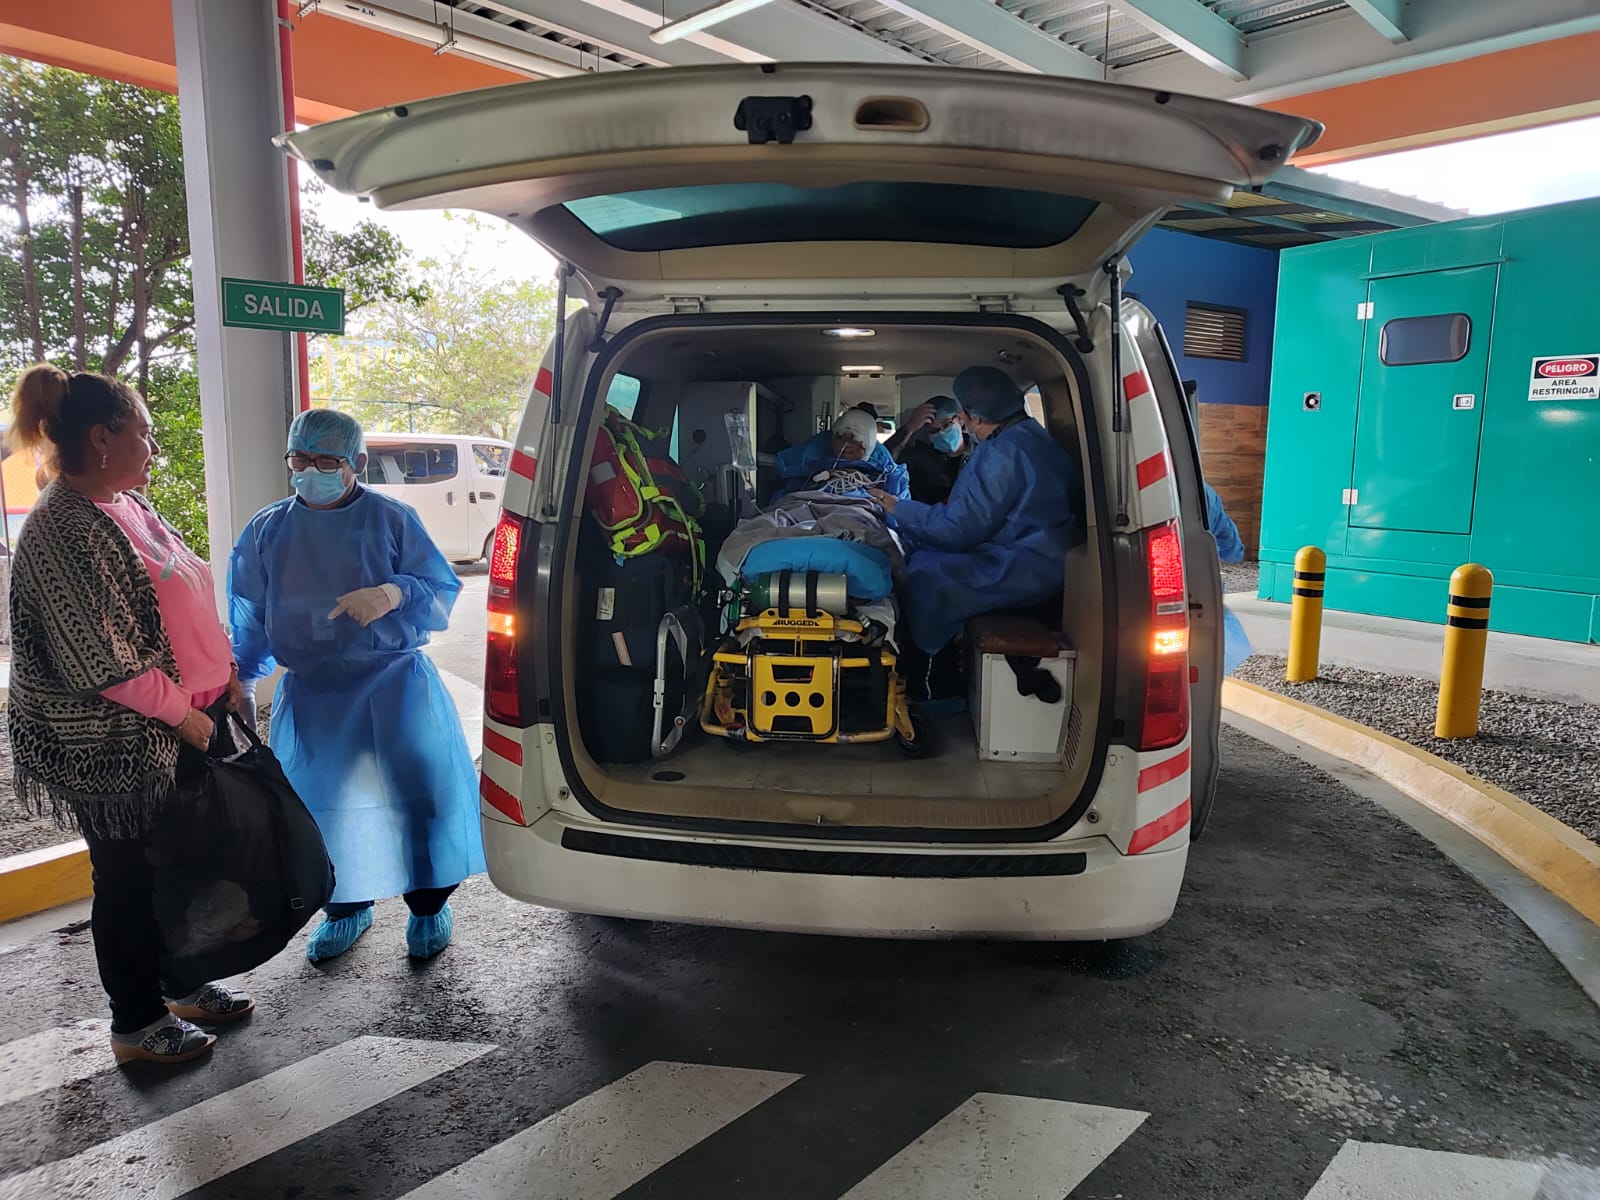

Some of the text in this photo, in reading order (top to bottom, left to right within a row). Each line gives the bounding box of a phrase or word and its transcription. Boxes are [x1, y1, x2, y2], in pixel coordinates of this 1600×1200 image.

[243, 293, 325, 320] SALIDA
[1545, 363, 1588, 374] PELIGRO
[1551, 378, 1577, 387] AREA
[1532, 386, 1595, 396] RESTRINGIDA
[777, 619, 815, 627] RUGGED
